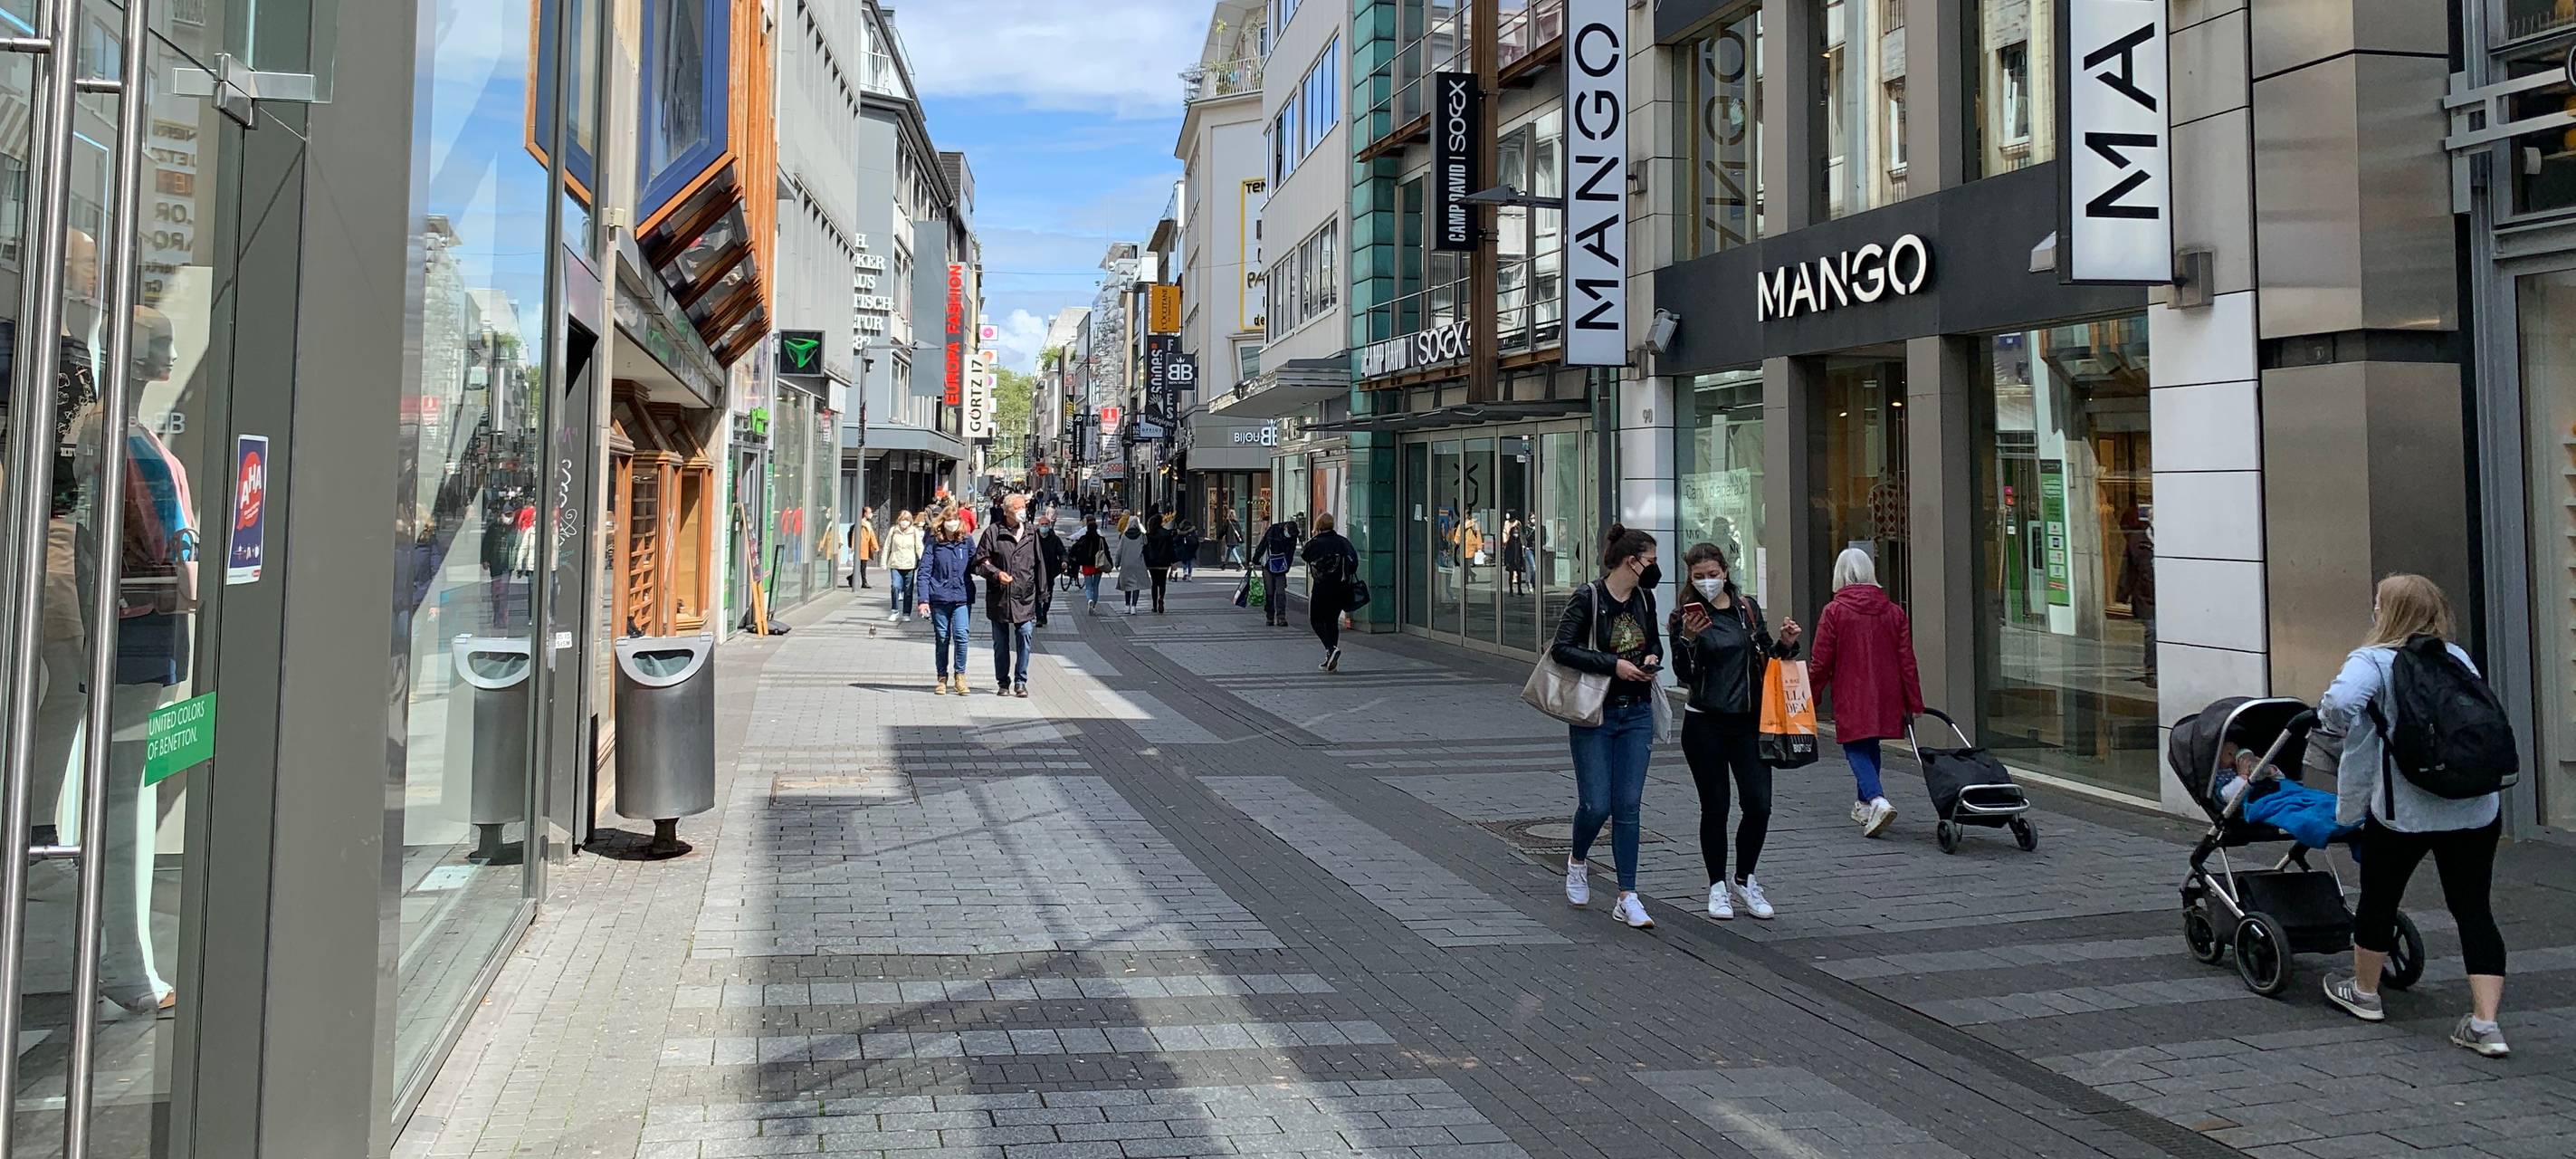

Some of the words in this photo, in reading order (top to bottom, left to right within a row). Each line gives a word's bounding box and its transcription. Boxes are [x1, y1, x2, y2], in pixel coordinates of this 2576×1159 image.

[2083, 0, 2159, 219] MA
[1448, 164, 1466, 203] DAVID
[1574, 22, 1620, 330] MANGO
[1448, 205, 1466, 242] CAMP
[1758, 234, 1928, 322] MANGO
[947, 264, 962, 334] FASHION
[945, 341, 961, 406] EUROPA
[971, 359, 984, 373] 17
[1168, 364, 1193, 380] BB
[1364, 343, 1384, 378] CAMP
[1385, 338, 1406, 372] DAVID
[1066, 397, 1074, 433] SUBWAY
[1643, 408, 1653, 424] 90
[1234, 432, 1260, 445] BIJOU
[240, 464, 262, 510] AHA
[149, 711, 177, 735] UNITED
[177, 701, 205, 725] COLORS
[148, 740, 158, 761] OF
